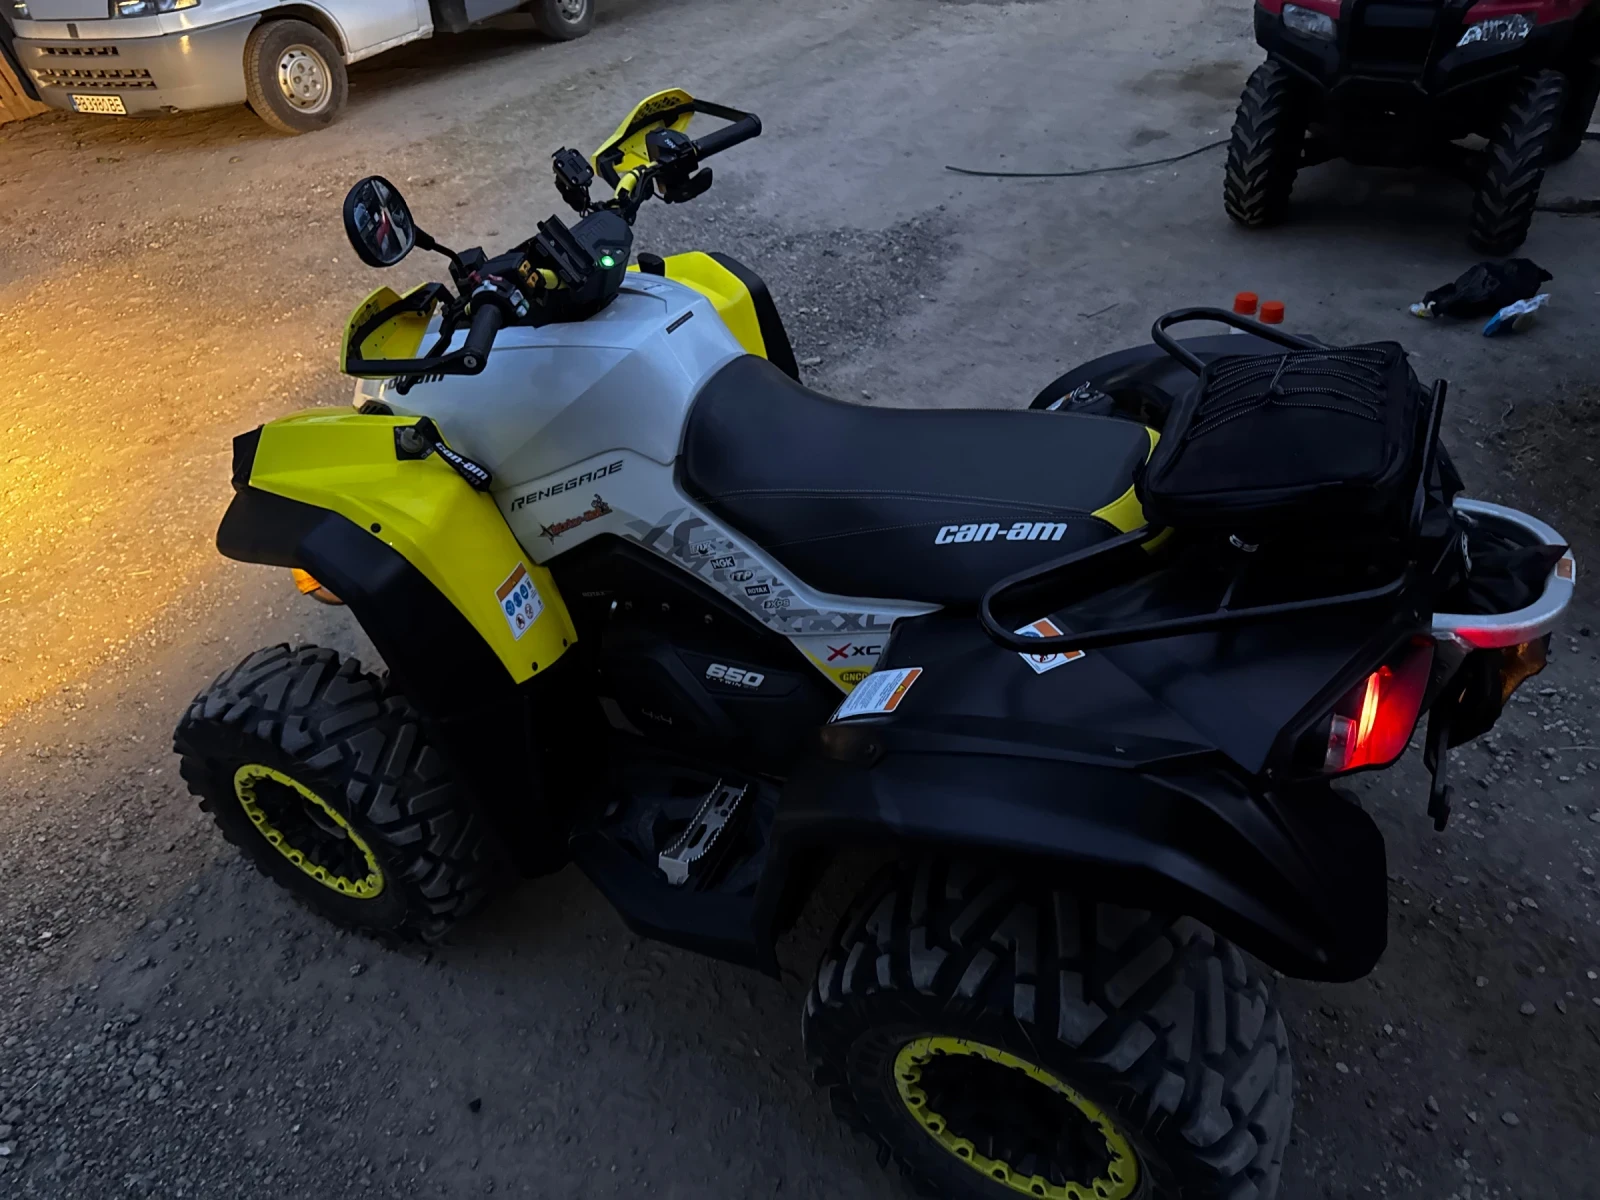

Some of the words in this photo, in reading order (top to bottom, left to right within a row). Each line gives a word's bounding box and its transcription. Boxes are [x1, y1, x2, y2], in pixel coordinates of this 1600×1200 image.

[435, 441, 489, 481] can-am
[511, 460, 623, 512] RENEGADE
[934, 521, 1068, 546] can-am
[712, 557, 735, 569] NGK
[731, 570, 753, 581] ITP
[746, 585, 768, 595] ROTAX
[706, 662, 765, 687] 650
